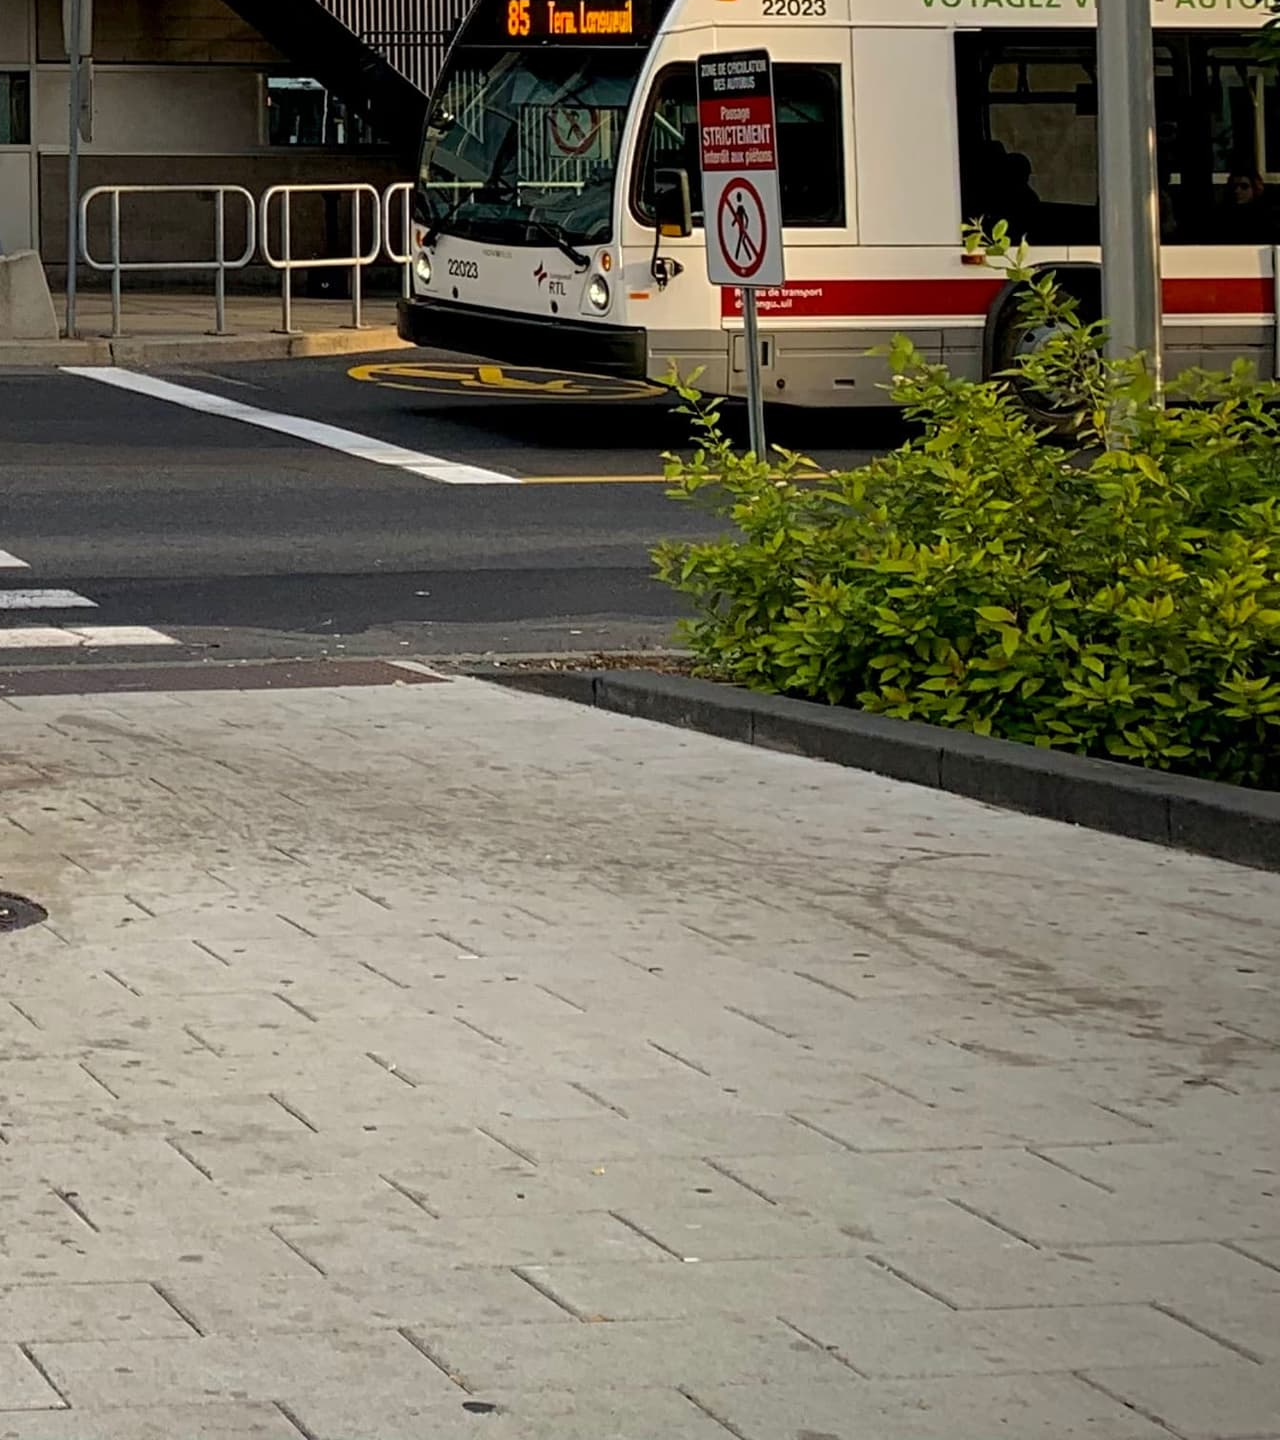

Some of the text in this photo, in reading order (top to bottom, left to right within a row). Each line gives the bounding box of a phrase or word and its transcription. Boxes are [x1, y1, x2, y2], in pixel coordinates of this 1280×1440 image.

[508, 0, 531, 36] 85
[703, 124, 770, 146] STRICTEMENT
[448, 259, 478, 278] 22023
[549, 281, 566, 296] RTL
[768, 288, 779, 297] de
[782, 288, 822, 298] transport
